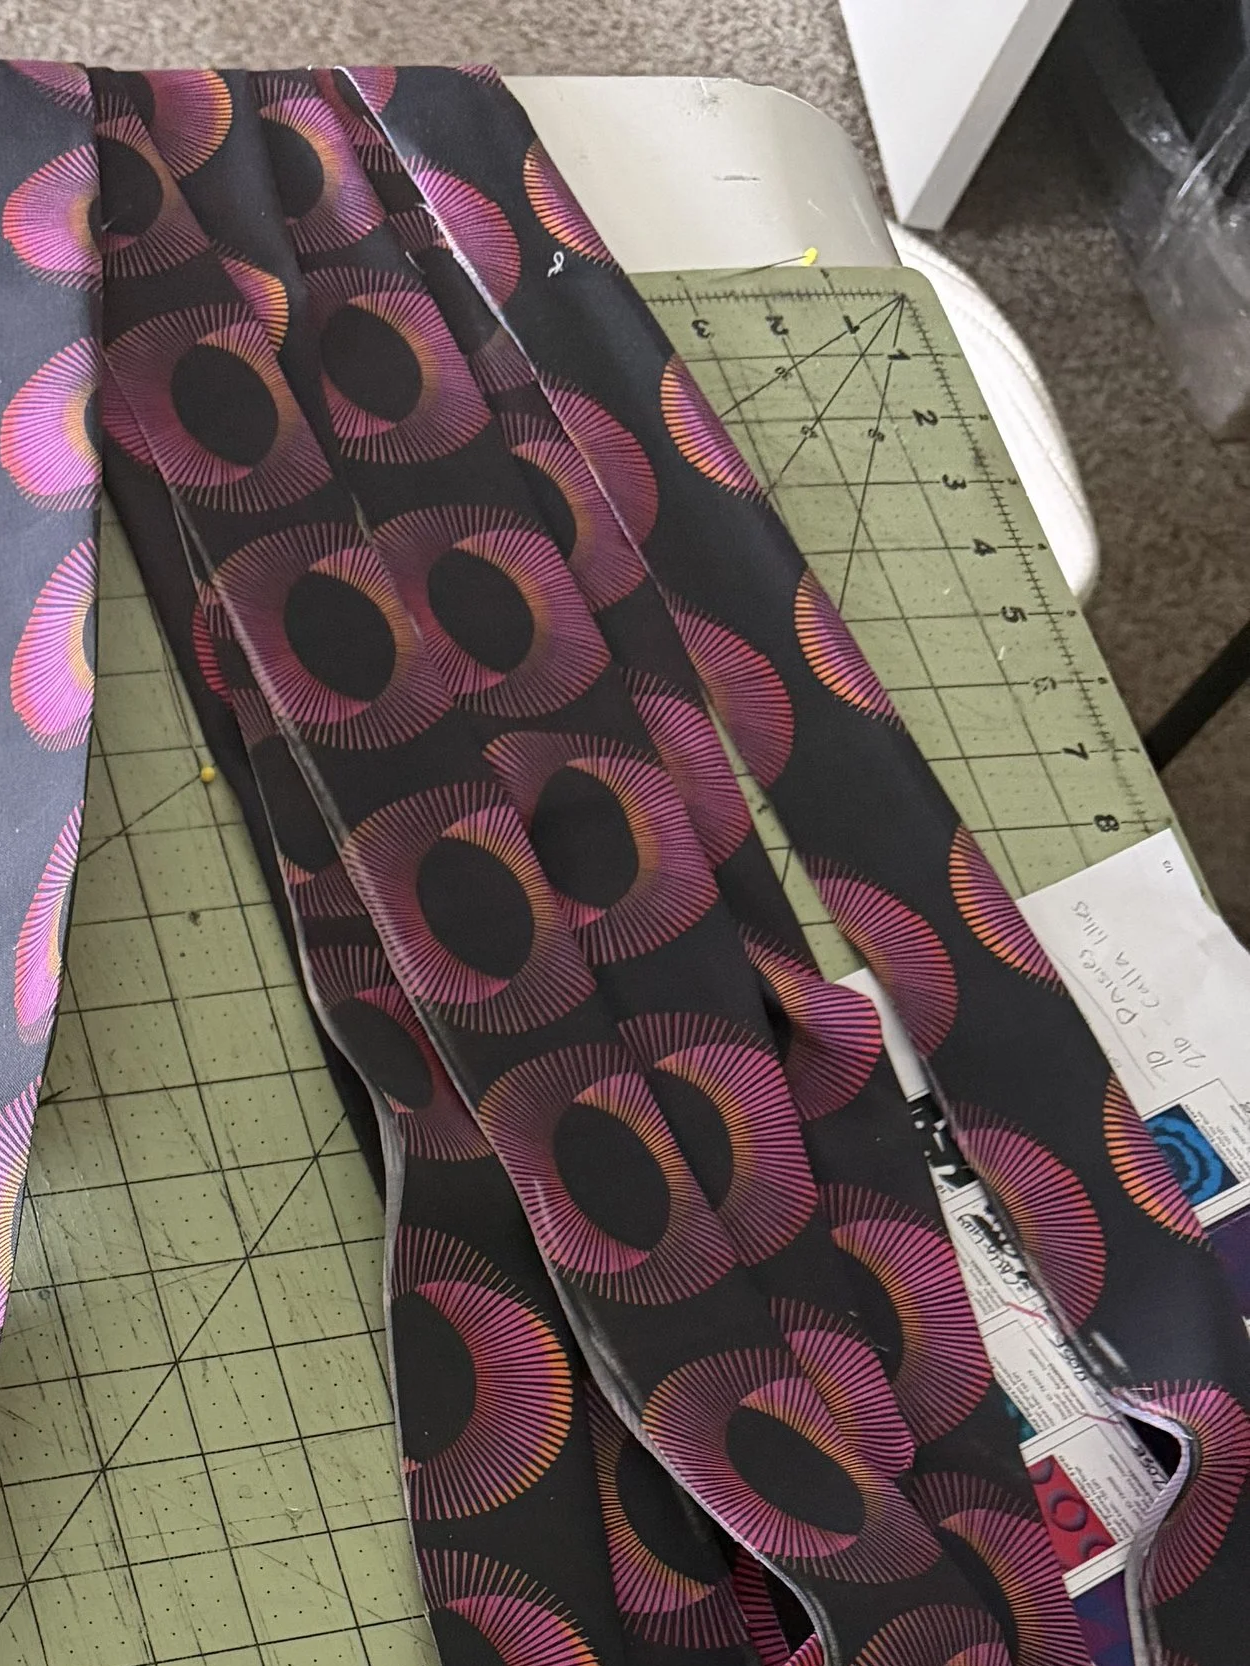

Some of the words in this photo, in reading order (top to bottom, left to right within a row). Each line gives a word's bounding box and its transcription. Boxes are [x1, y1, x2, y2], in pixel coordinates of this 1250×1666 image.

[692, 319, 714, 339] 3
[766, 314, 789, 336] 2
[843, 314, 861, 334] 1
[887, 348, 912, 361] 1
[912, 408, 939, 427] 2
[942, 474, 967, 490] 3
[972, 538, 998, 557] 4
[1001, 605, 1028, 624] 5
[1062, 742, 1090, 761] 7
[1093, 814, 1120, 833] 8
[1162, 859, 1174, 874] 1/3
